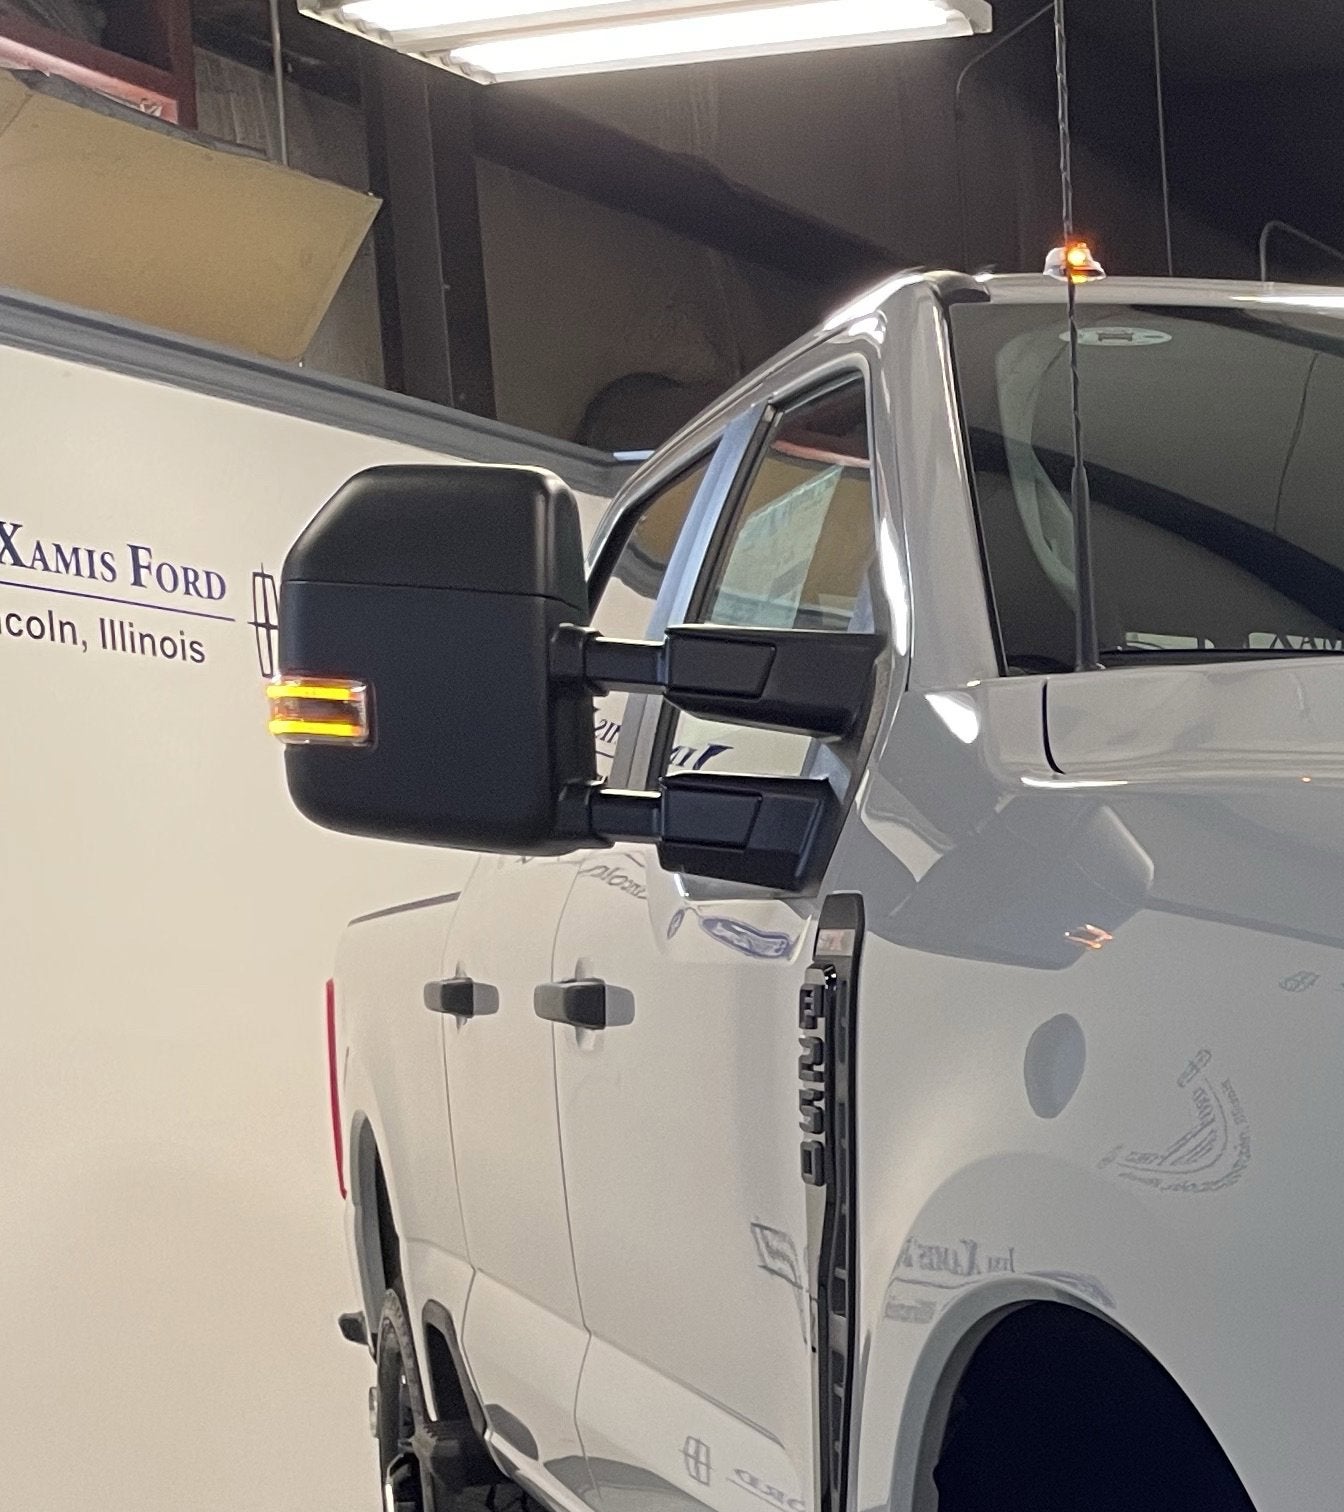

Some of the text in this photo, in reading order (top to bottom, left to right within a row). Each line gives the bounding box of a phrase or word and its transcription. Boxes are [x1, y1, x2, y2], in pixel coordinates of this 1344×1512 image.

[0, 521, 226, 601] XAMIS FORD
[0, 610, 205, 664] coln, Illinois
